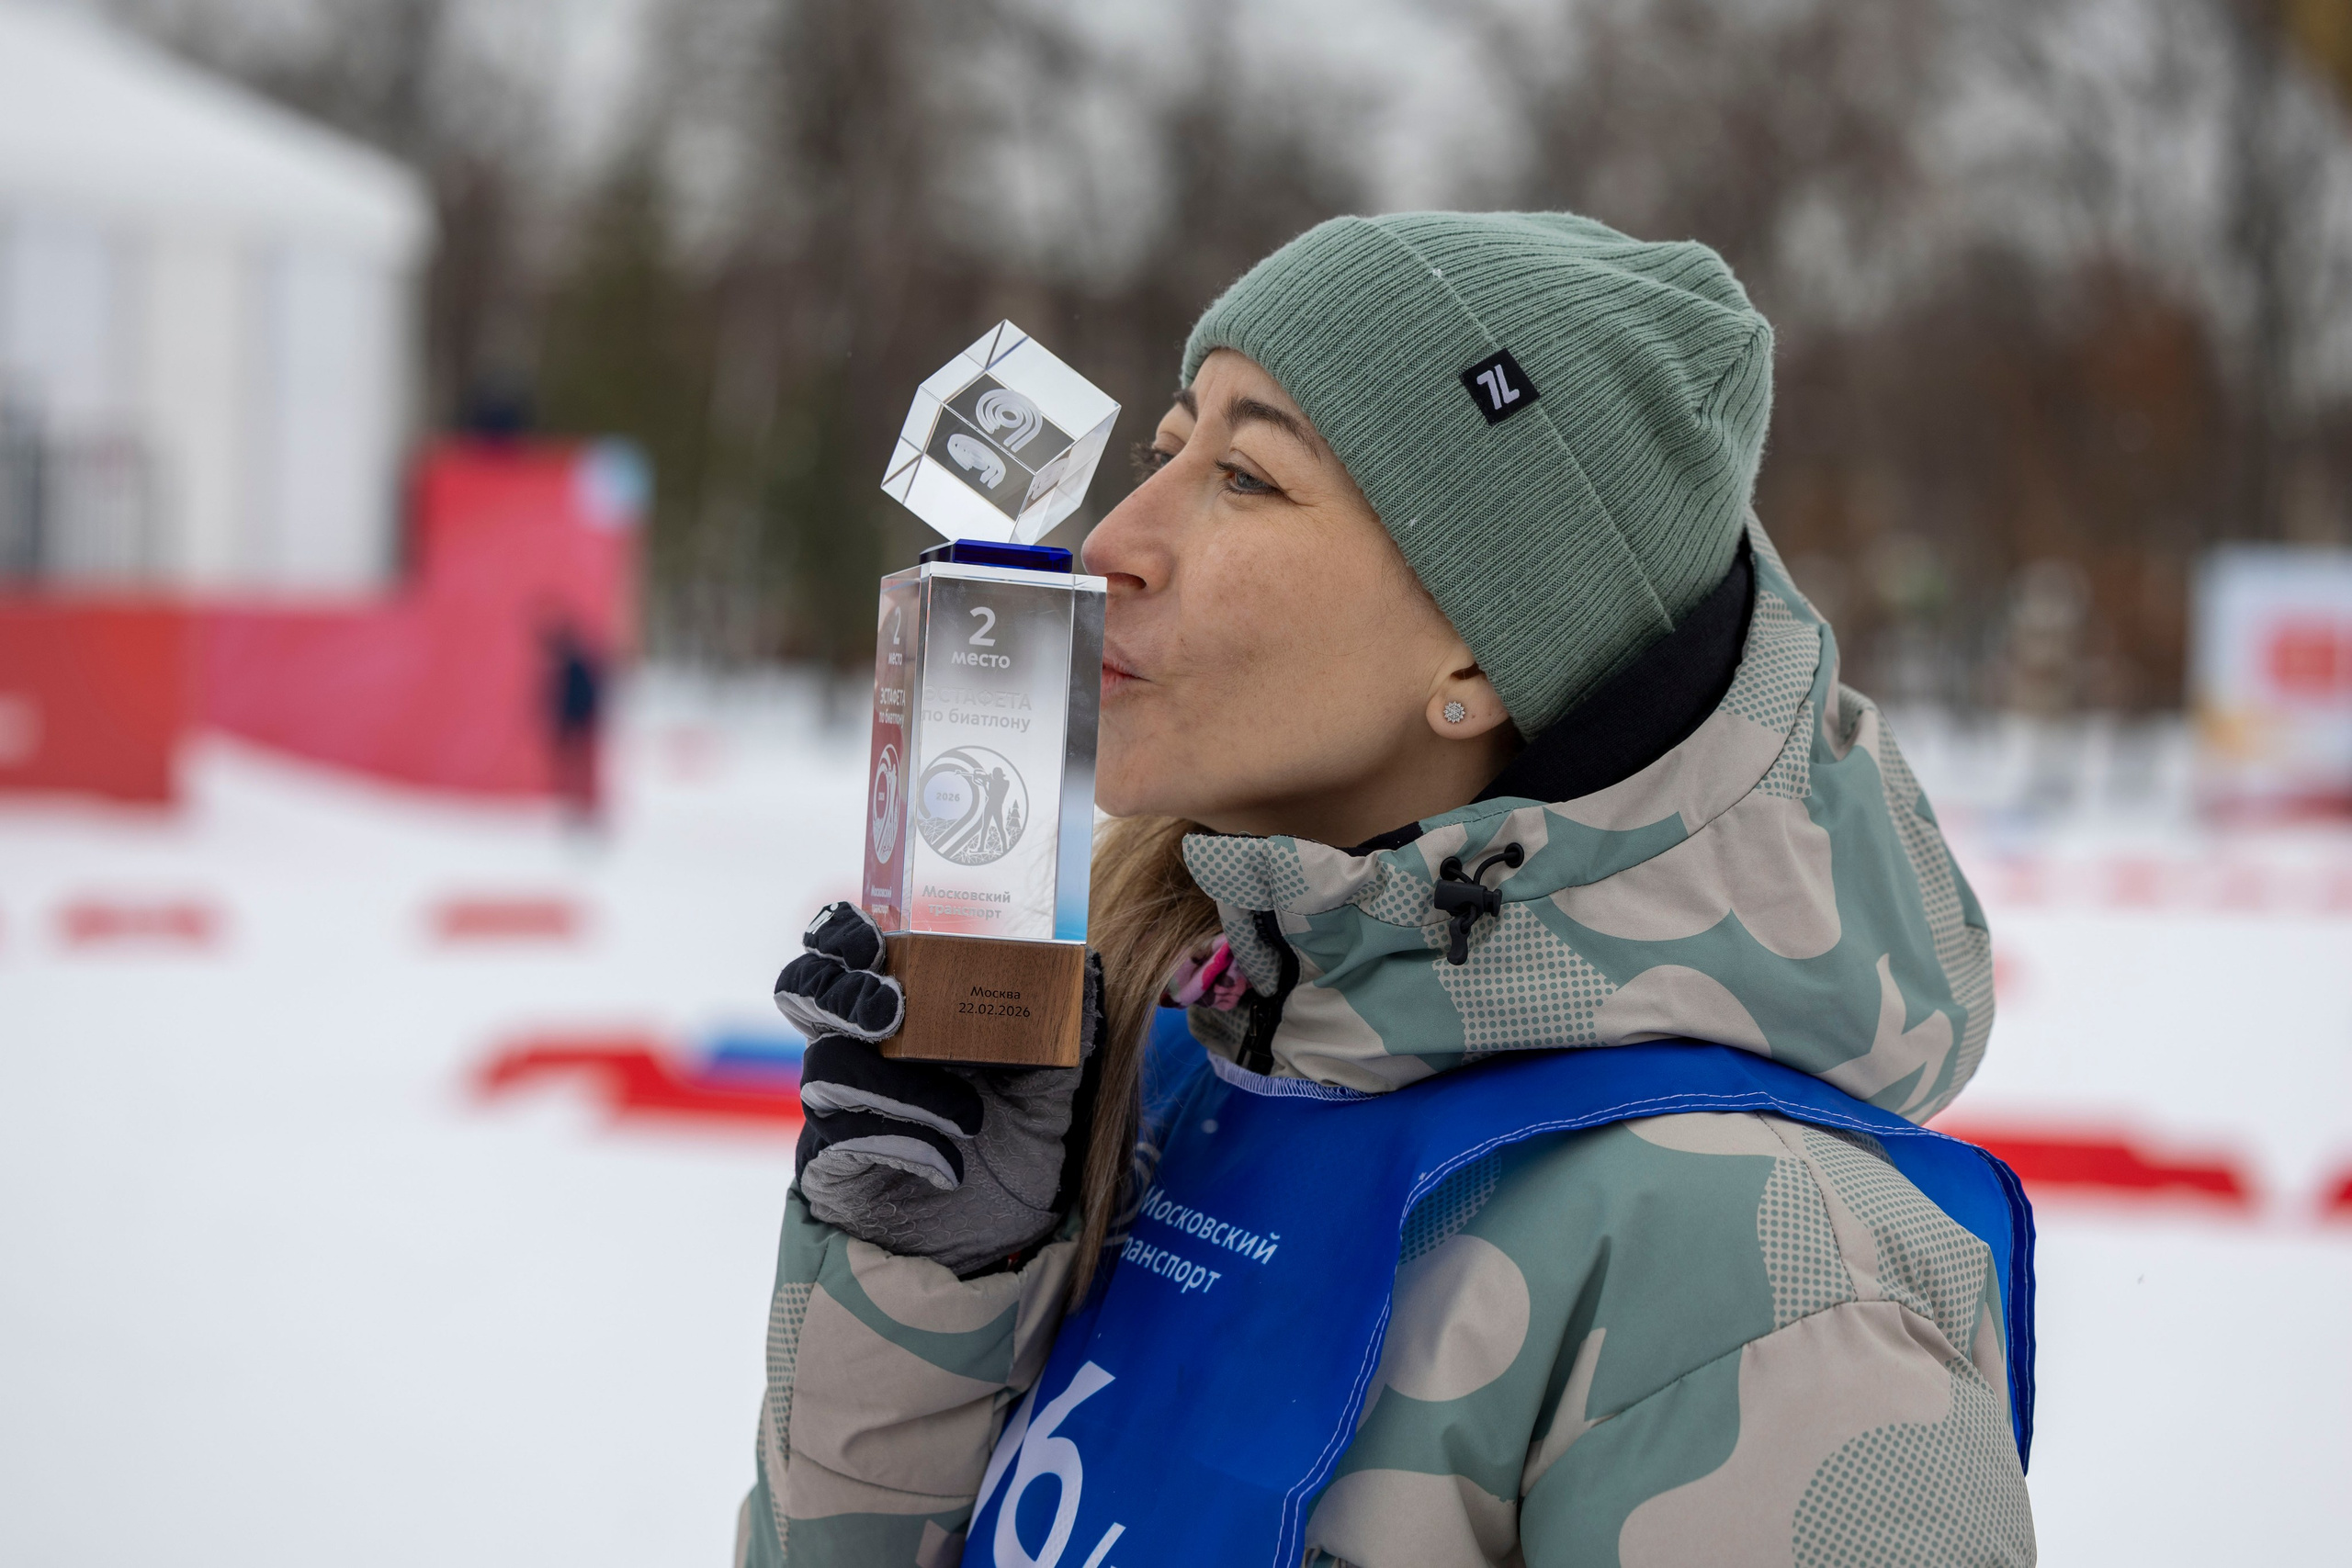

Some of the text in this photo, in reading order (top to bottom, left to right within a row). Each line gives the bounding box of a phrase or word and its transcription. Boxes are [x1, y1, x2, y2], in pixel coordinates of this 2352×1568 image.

[893, 605, 901, 645] 2
[968, 606, 996, 647] 2
[951, 650, 1011, 669] место
[923, 685, 1032, 711] ЭСТАФЕТА
[922, 708, 1031, 733] по биатлону
[936, 793, 960, 802] 2026
[922, 885, 1011, 903] Московский
[928, 904, 1001, 920] транспорт
[970, 986, 1021, 999] Москва
[958, 1002, 1031, 1018] 22.02.2026
